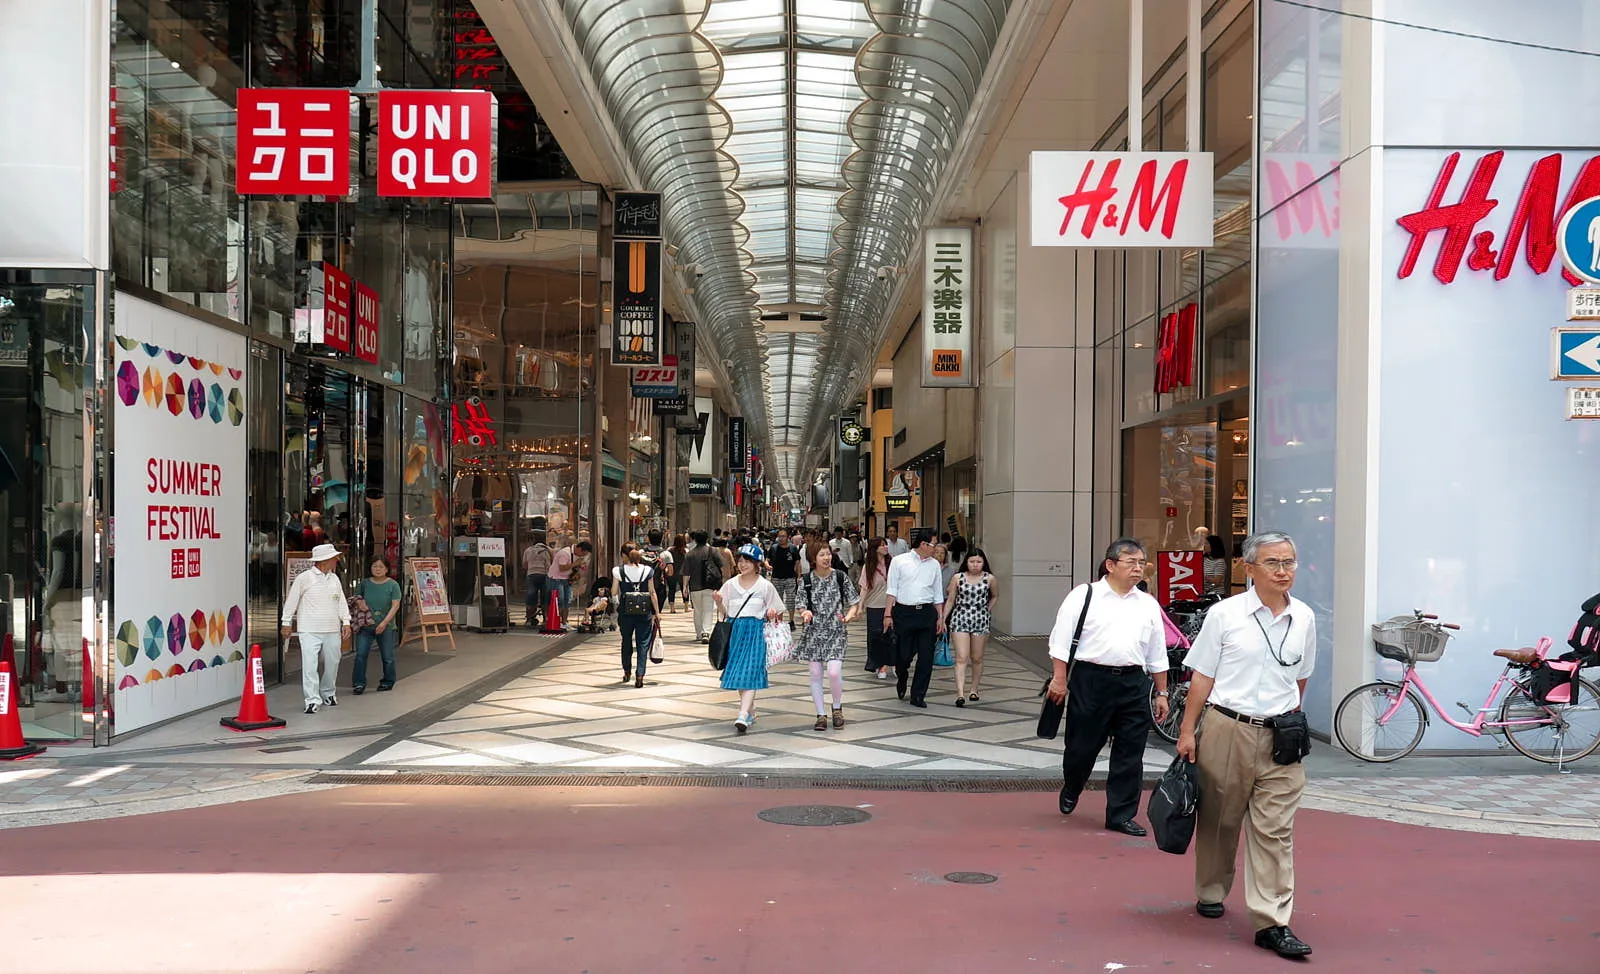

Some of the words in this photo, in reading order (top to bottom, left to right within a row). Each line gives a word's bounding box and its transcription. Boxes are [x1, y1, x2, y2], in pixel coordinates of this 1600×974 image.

[252, 103, 334, 137] ユニ
[391, 105, 470, 140] UNI
[249, 147, 334, 181] クロ
[391, 149, 478, 189] QLO
[1058, 158, 1189, 240] H&M
[933, 243, 963, 334] 三木楽器
[358, 292, 375, 324] UNI
[358, 324, 377, 355] QLO
[618, 336, 654, 352] TOR
[619, 319, 654, 336] DOU
[635, 370, 676, 382] クスリ
[934, 363, 960, 372] GAKKI
[937, 355, 957, 363] MIKI
[147, 457, 221, 497] SUMMER
[147, 504, 221, 541] FESTIVAL
